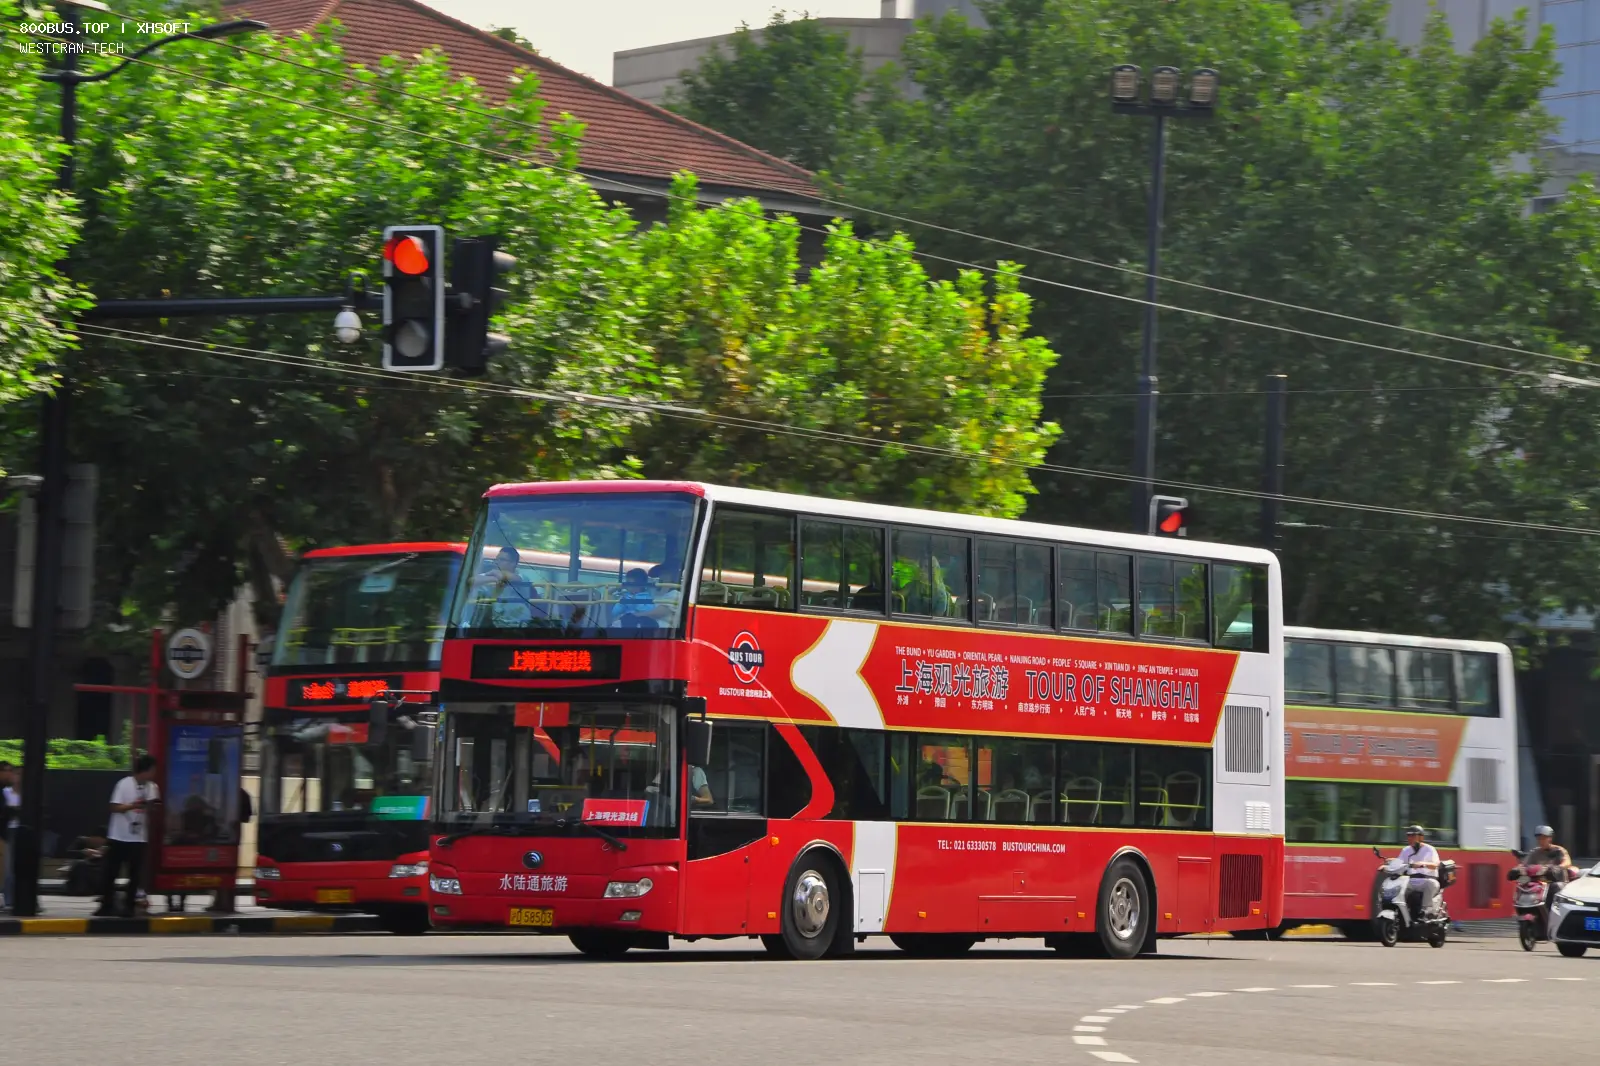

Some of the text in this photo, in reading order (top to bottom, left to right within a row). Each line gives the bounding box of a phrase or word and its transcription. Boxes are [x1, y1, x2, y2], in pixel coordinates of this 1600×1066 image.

[729, 651, 763, 664] BUS TOUR
[895, 646, 906, 656] THE
[906, 646, 922, 657] BUND
[927, 648, 935, 658] YU
[935, 649, 957, 660] GARDEN
[963, 651, 987, 662] ORIENTAL
[987, 653, 1003, 663] PEARL
[1009, 654, 1032, 665] NANJING
[1032, 656, 1046, 665] ROAD
[1078, 660, 1097, 670] SQUARE
[1156, 666, 1174, 676] TEMPLE
[895, 658, 1009, 699] 上海观光旅游
[719, 687, 745, 697] BUSTOUR
[1026, 669, 1199, 710] TOUR OF SHANGHAI
[1018, 702, 1051, 715] 南京路步行街
[1074, 705, 1095, 717] 人民广场
[1116, 708, 1132, 719] 新天地
[953, 841, 966, 850] 021
[966, 841, 997, 851] 63330578
[1002, 841, 1066, 853] BUSTOURCHINA.COM
[499, 874, 568, 892] 水陆通旅游
